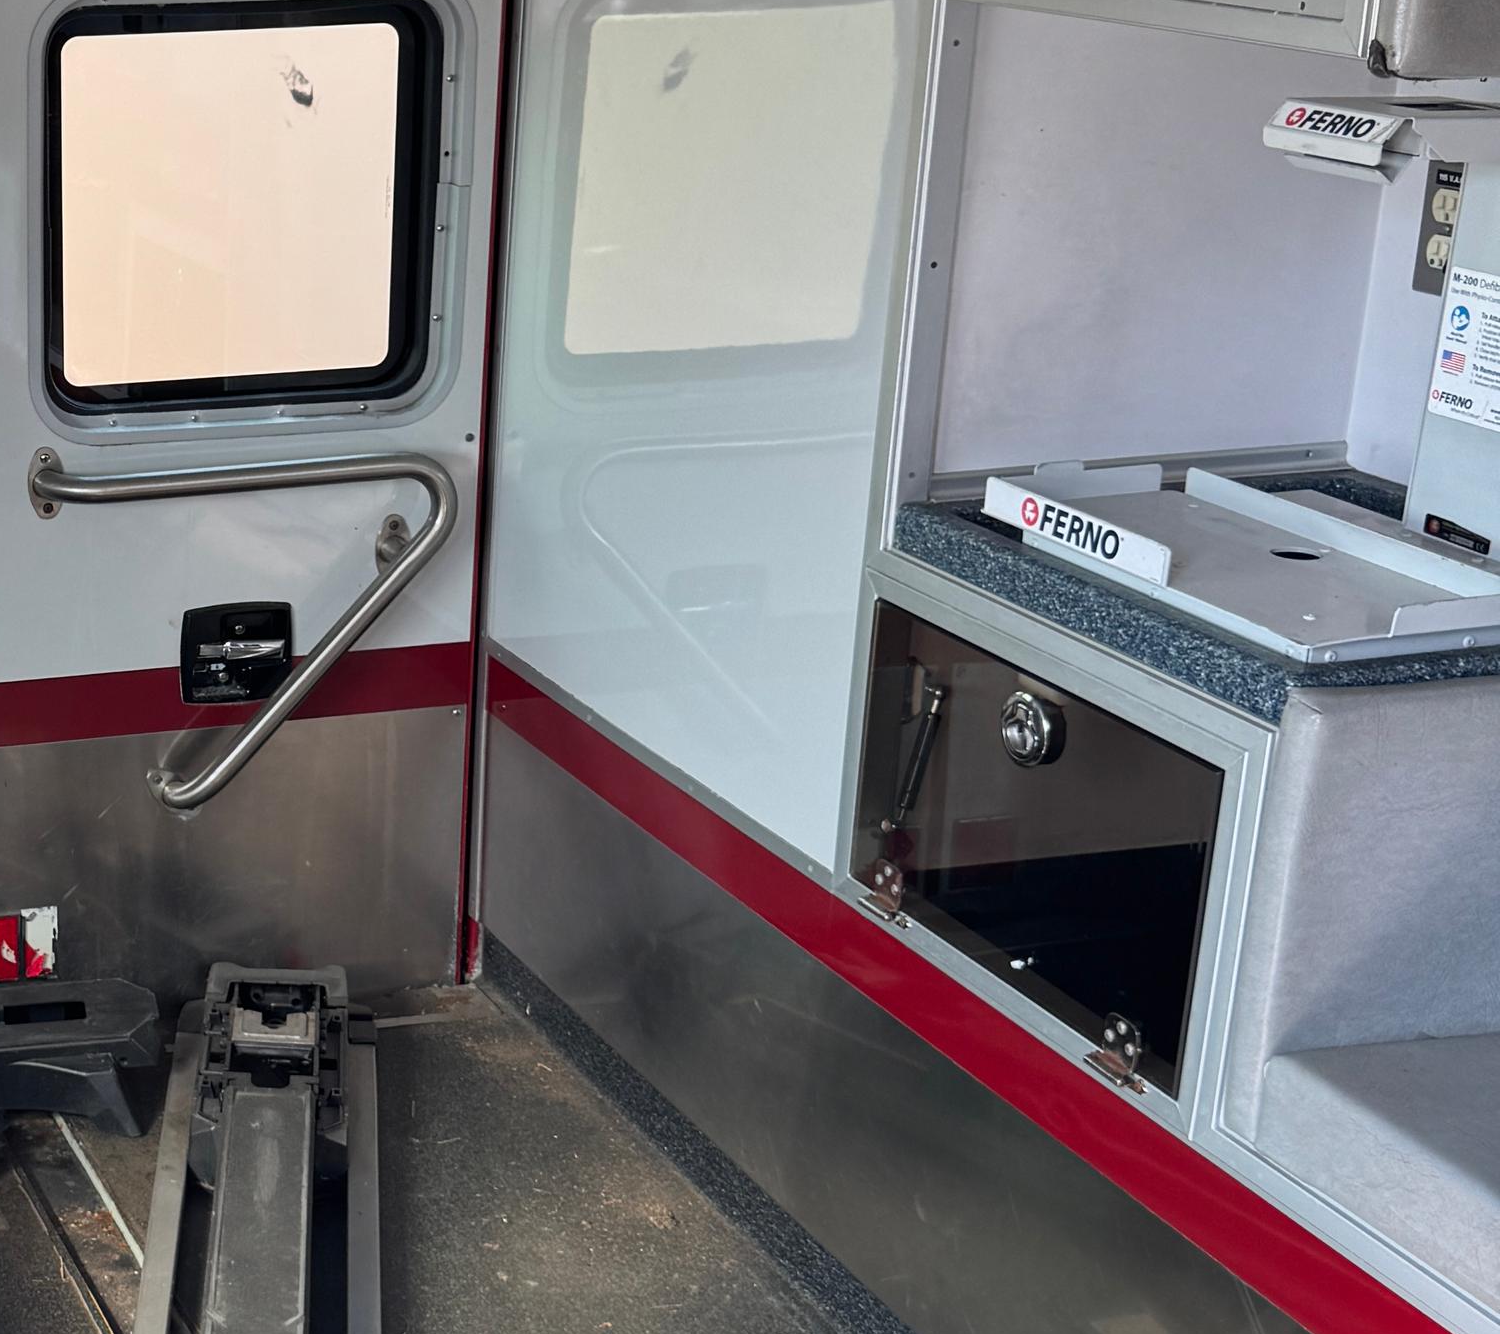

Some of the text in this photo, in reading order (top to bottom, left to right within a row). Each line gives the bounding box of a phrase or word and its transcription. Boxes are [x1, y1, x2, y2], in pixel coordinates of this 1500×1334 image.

[1298, 109, 1376, 138] FERNO
[1452, 272, 1479, 287] M-200
[1439, 391, 1473, 410] FERNO
[1039, 503, 1120, 560] FERNO
